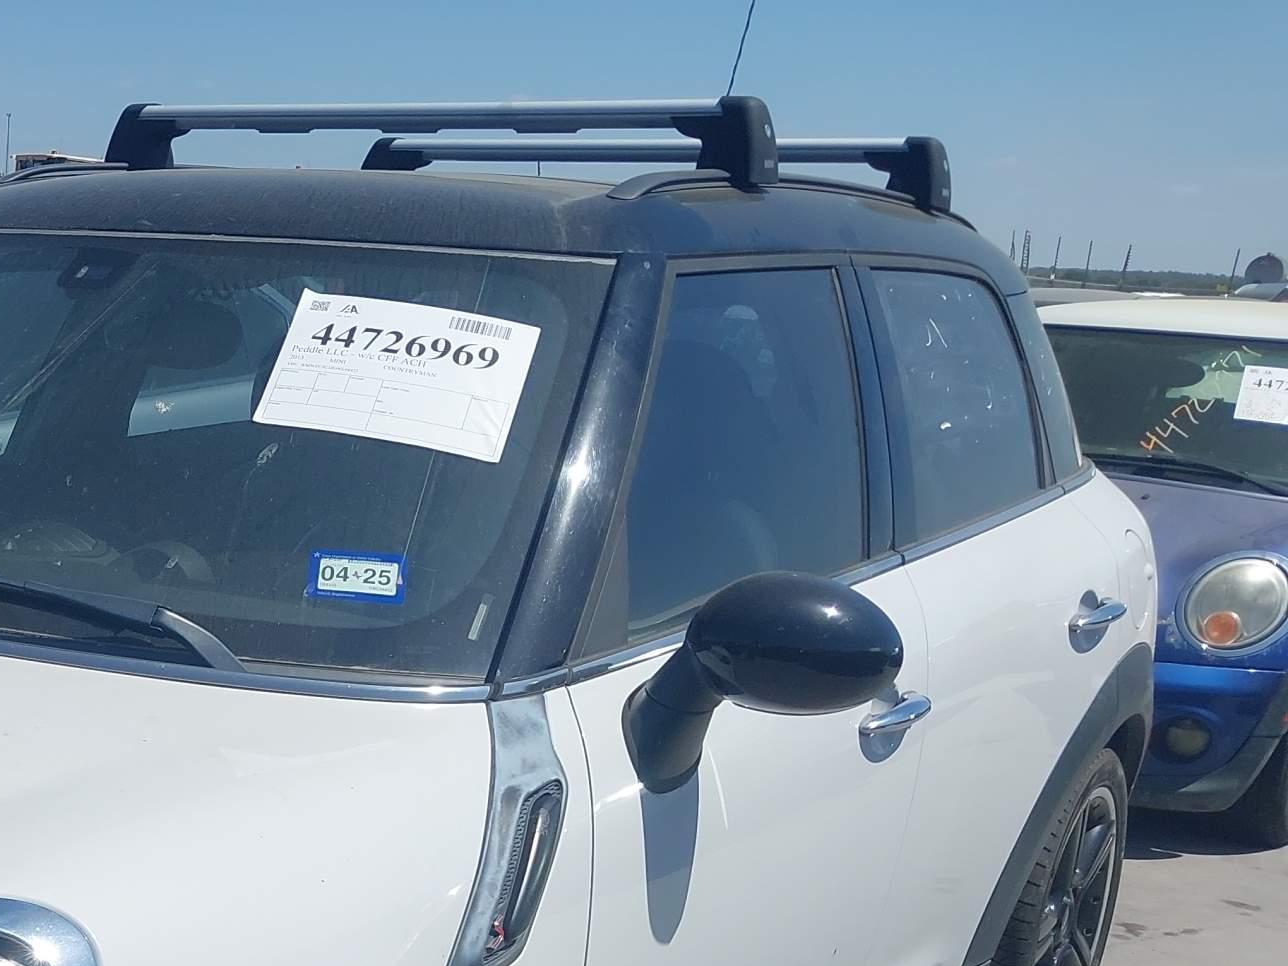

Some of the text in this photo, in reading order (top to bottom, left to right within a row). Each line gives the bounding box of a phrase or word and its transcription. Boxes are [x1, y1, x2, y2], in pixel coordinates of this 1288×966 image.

[292, 344, 324, 354] Peddle
[326, 348, 350, 357] LLC
[312, 323, 499, 369] 44726969
[383, 364, 437, 378] COUNTRYMAN
[321, 565, 392, 586] 04 25
